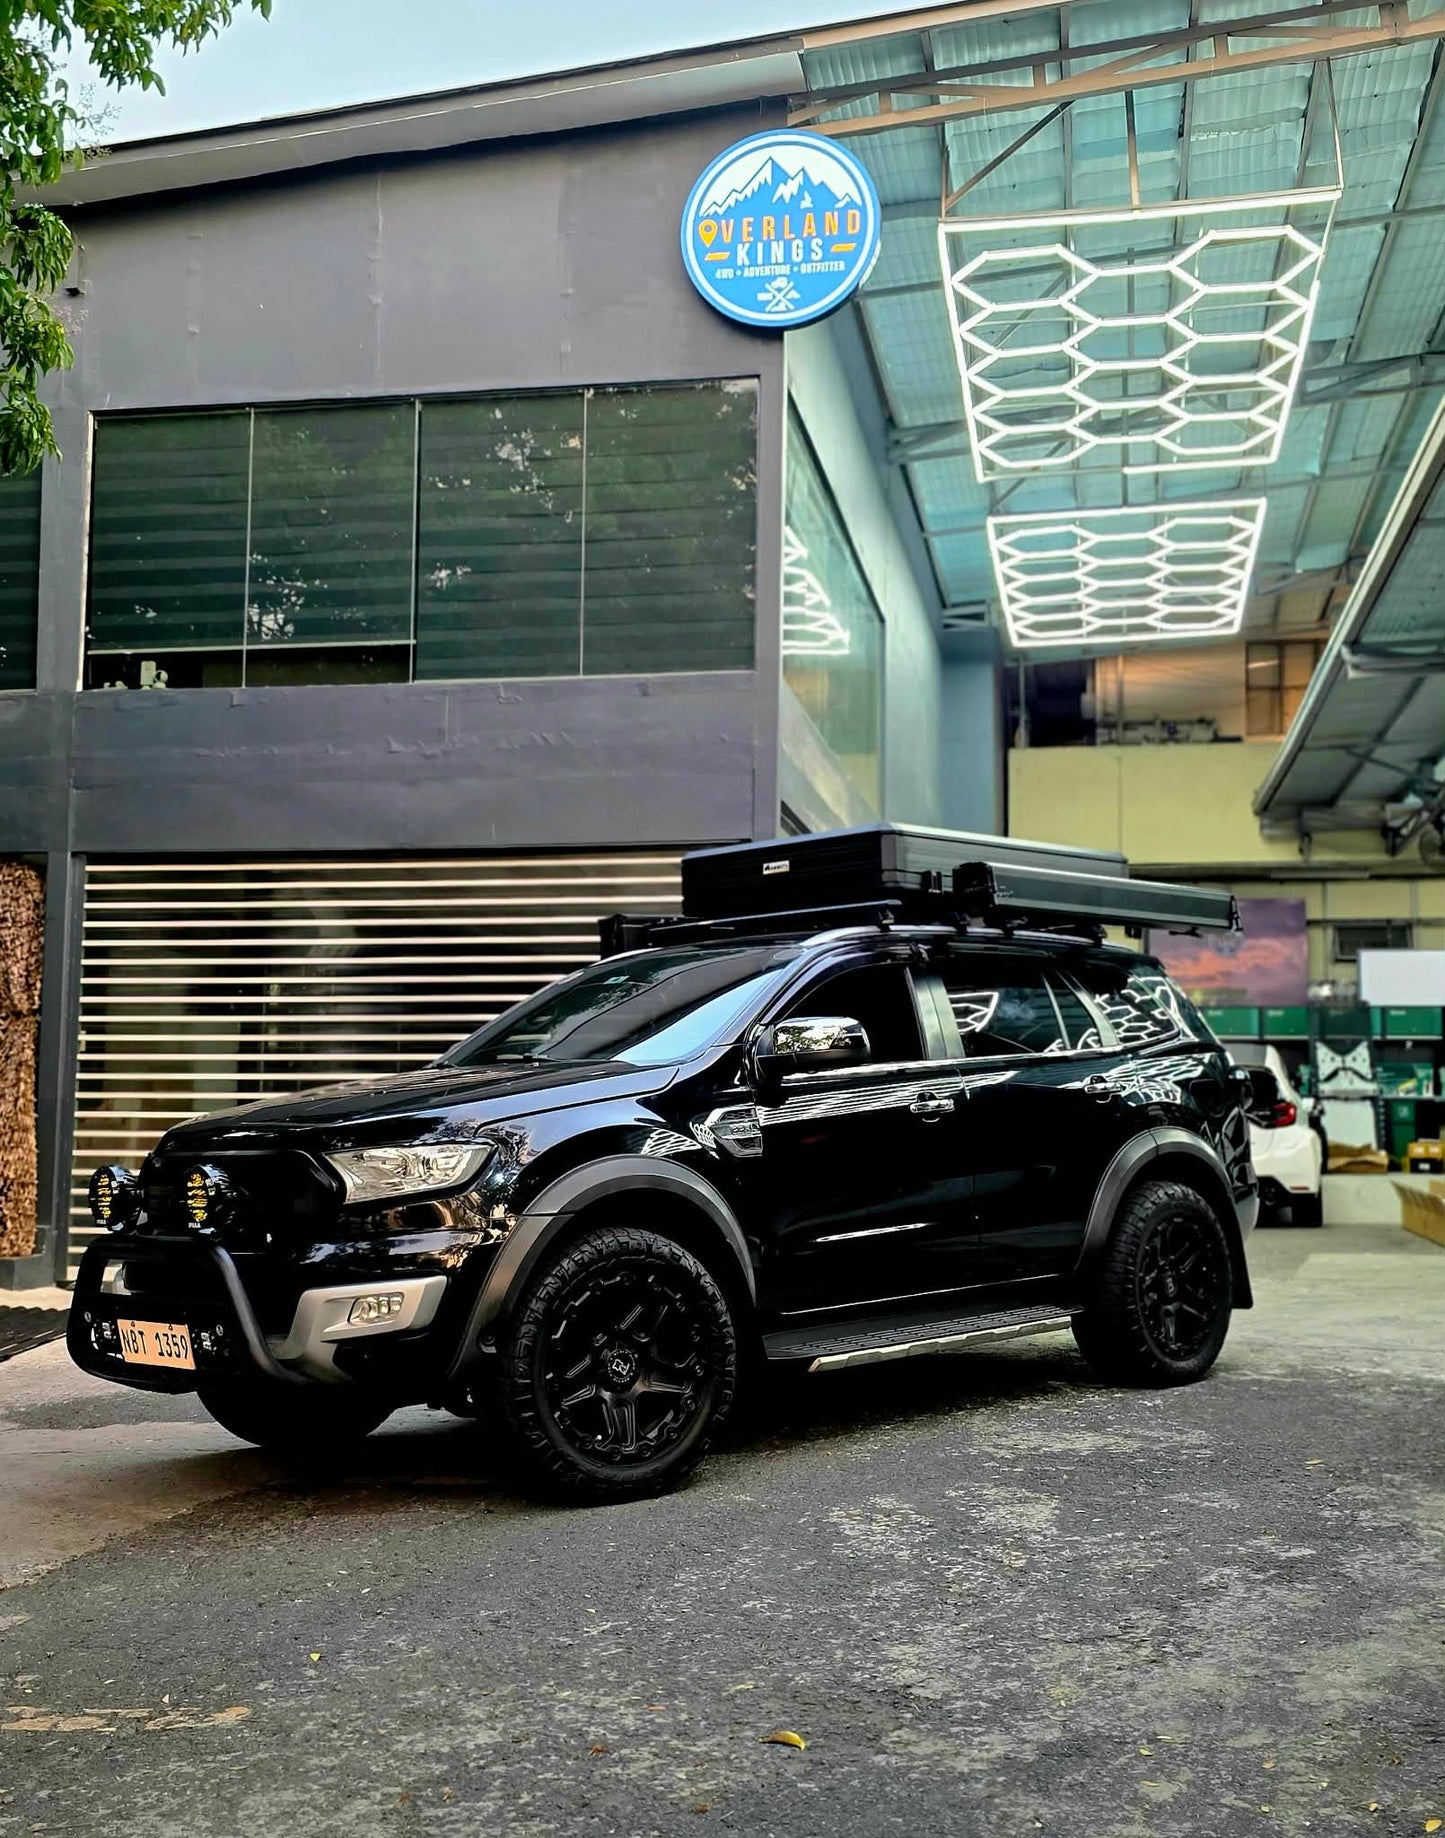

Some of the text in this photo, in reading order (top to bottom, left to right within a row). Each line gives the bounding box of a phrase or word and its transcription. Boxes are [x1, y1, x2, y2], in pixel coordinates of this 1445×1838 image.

[736, 237, 824, 267] KINGS
[715, 268, 735, 280] 4WD
[743, 263, 791, 278] ADVENTURE
[120, 1328, 189, 1360] NBT 1359
